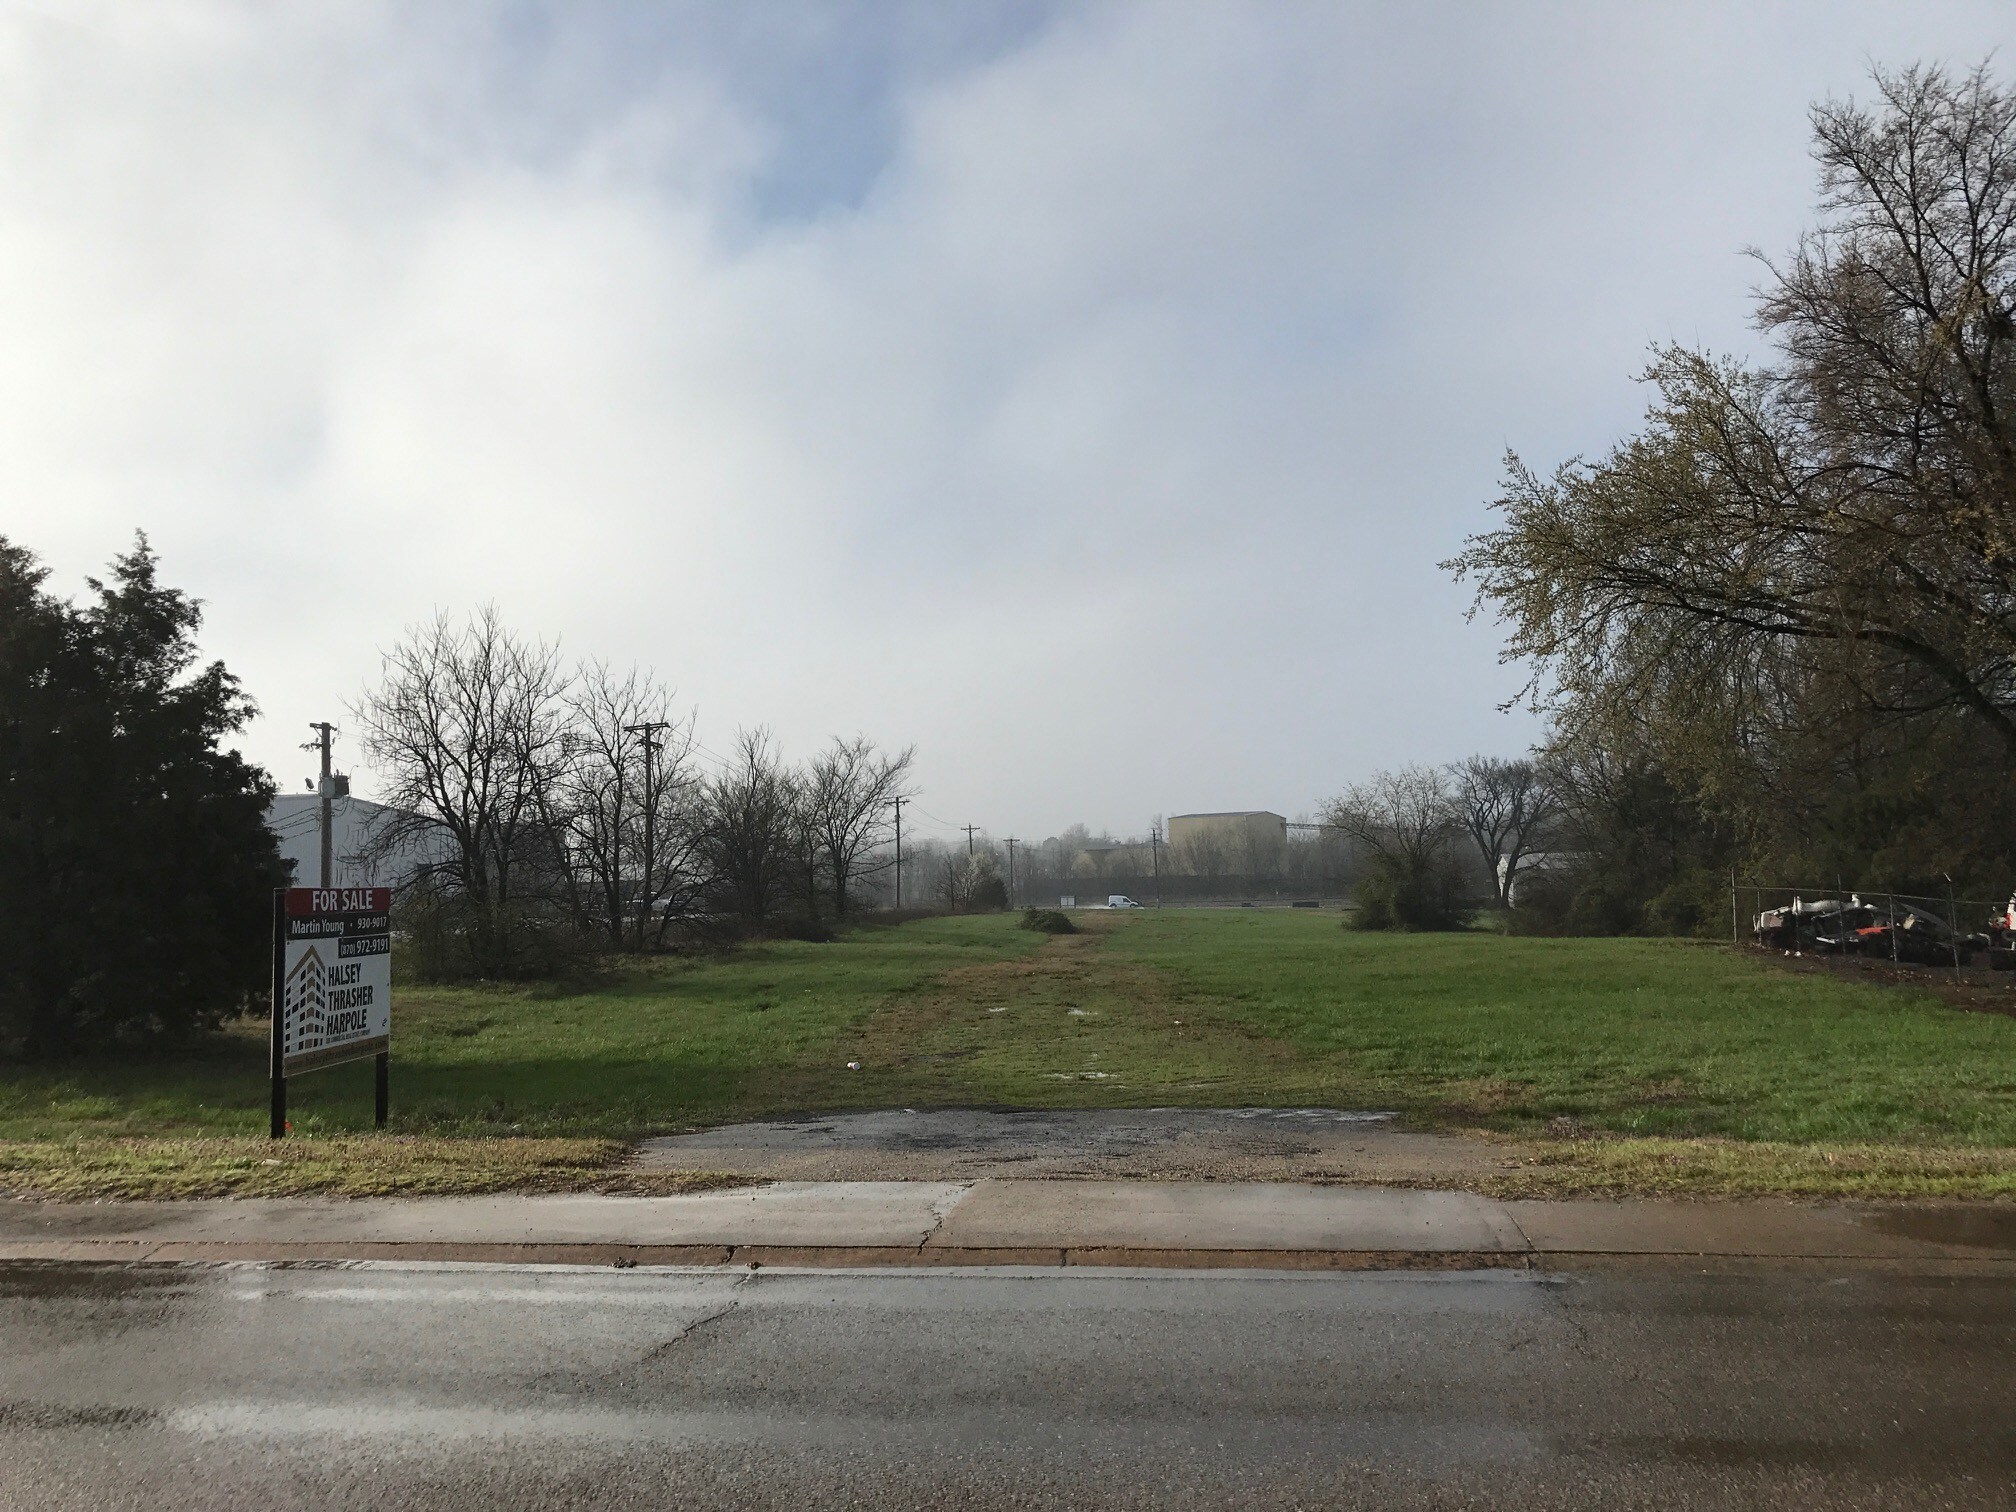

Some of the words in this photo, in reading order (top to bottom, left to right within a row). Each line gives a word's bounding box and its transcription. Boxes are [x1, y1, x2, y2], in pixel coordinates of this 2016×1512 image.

[312, 890, 338, 911] FOR
[342, 889, 373, 910] SALE
[291, 919, 320, 934] Martin
[322, 918, 344, 935] Young
[356, 938, 388, 953] 972-9191
[328, 963, 361, 987] HALSEY
[328, 985, 373, 1011] THRASHER
[326, 1008, 367, 1035] HARPOLE
